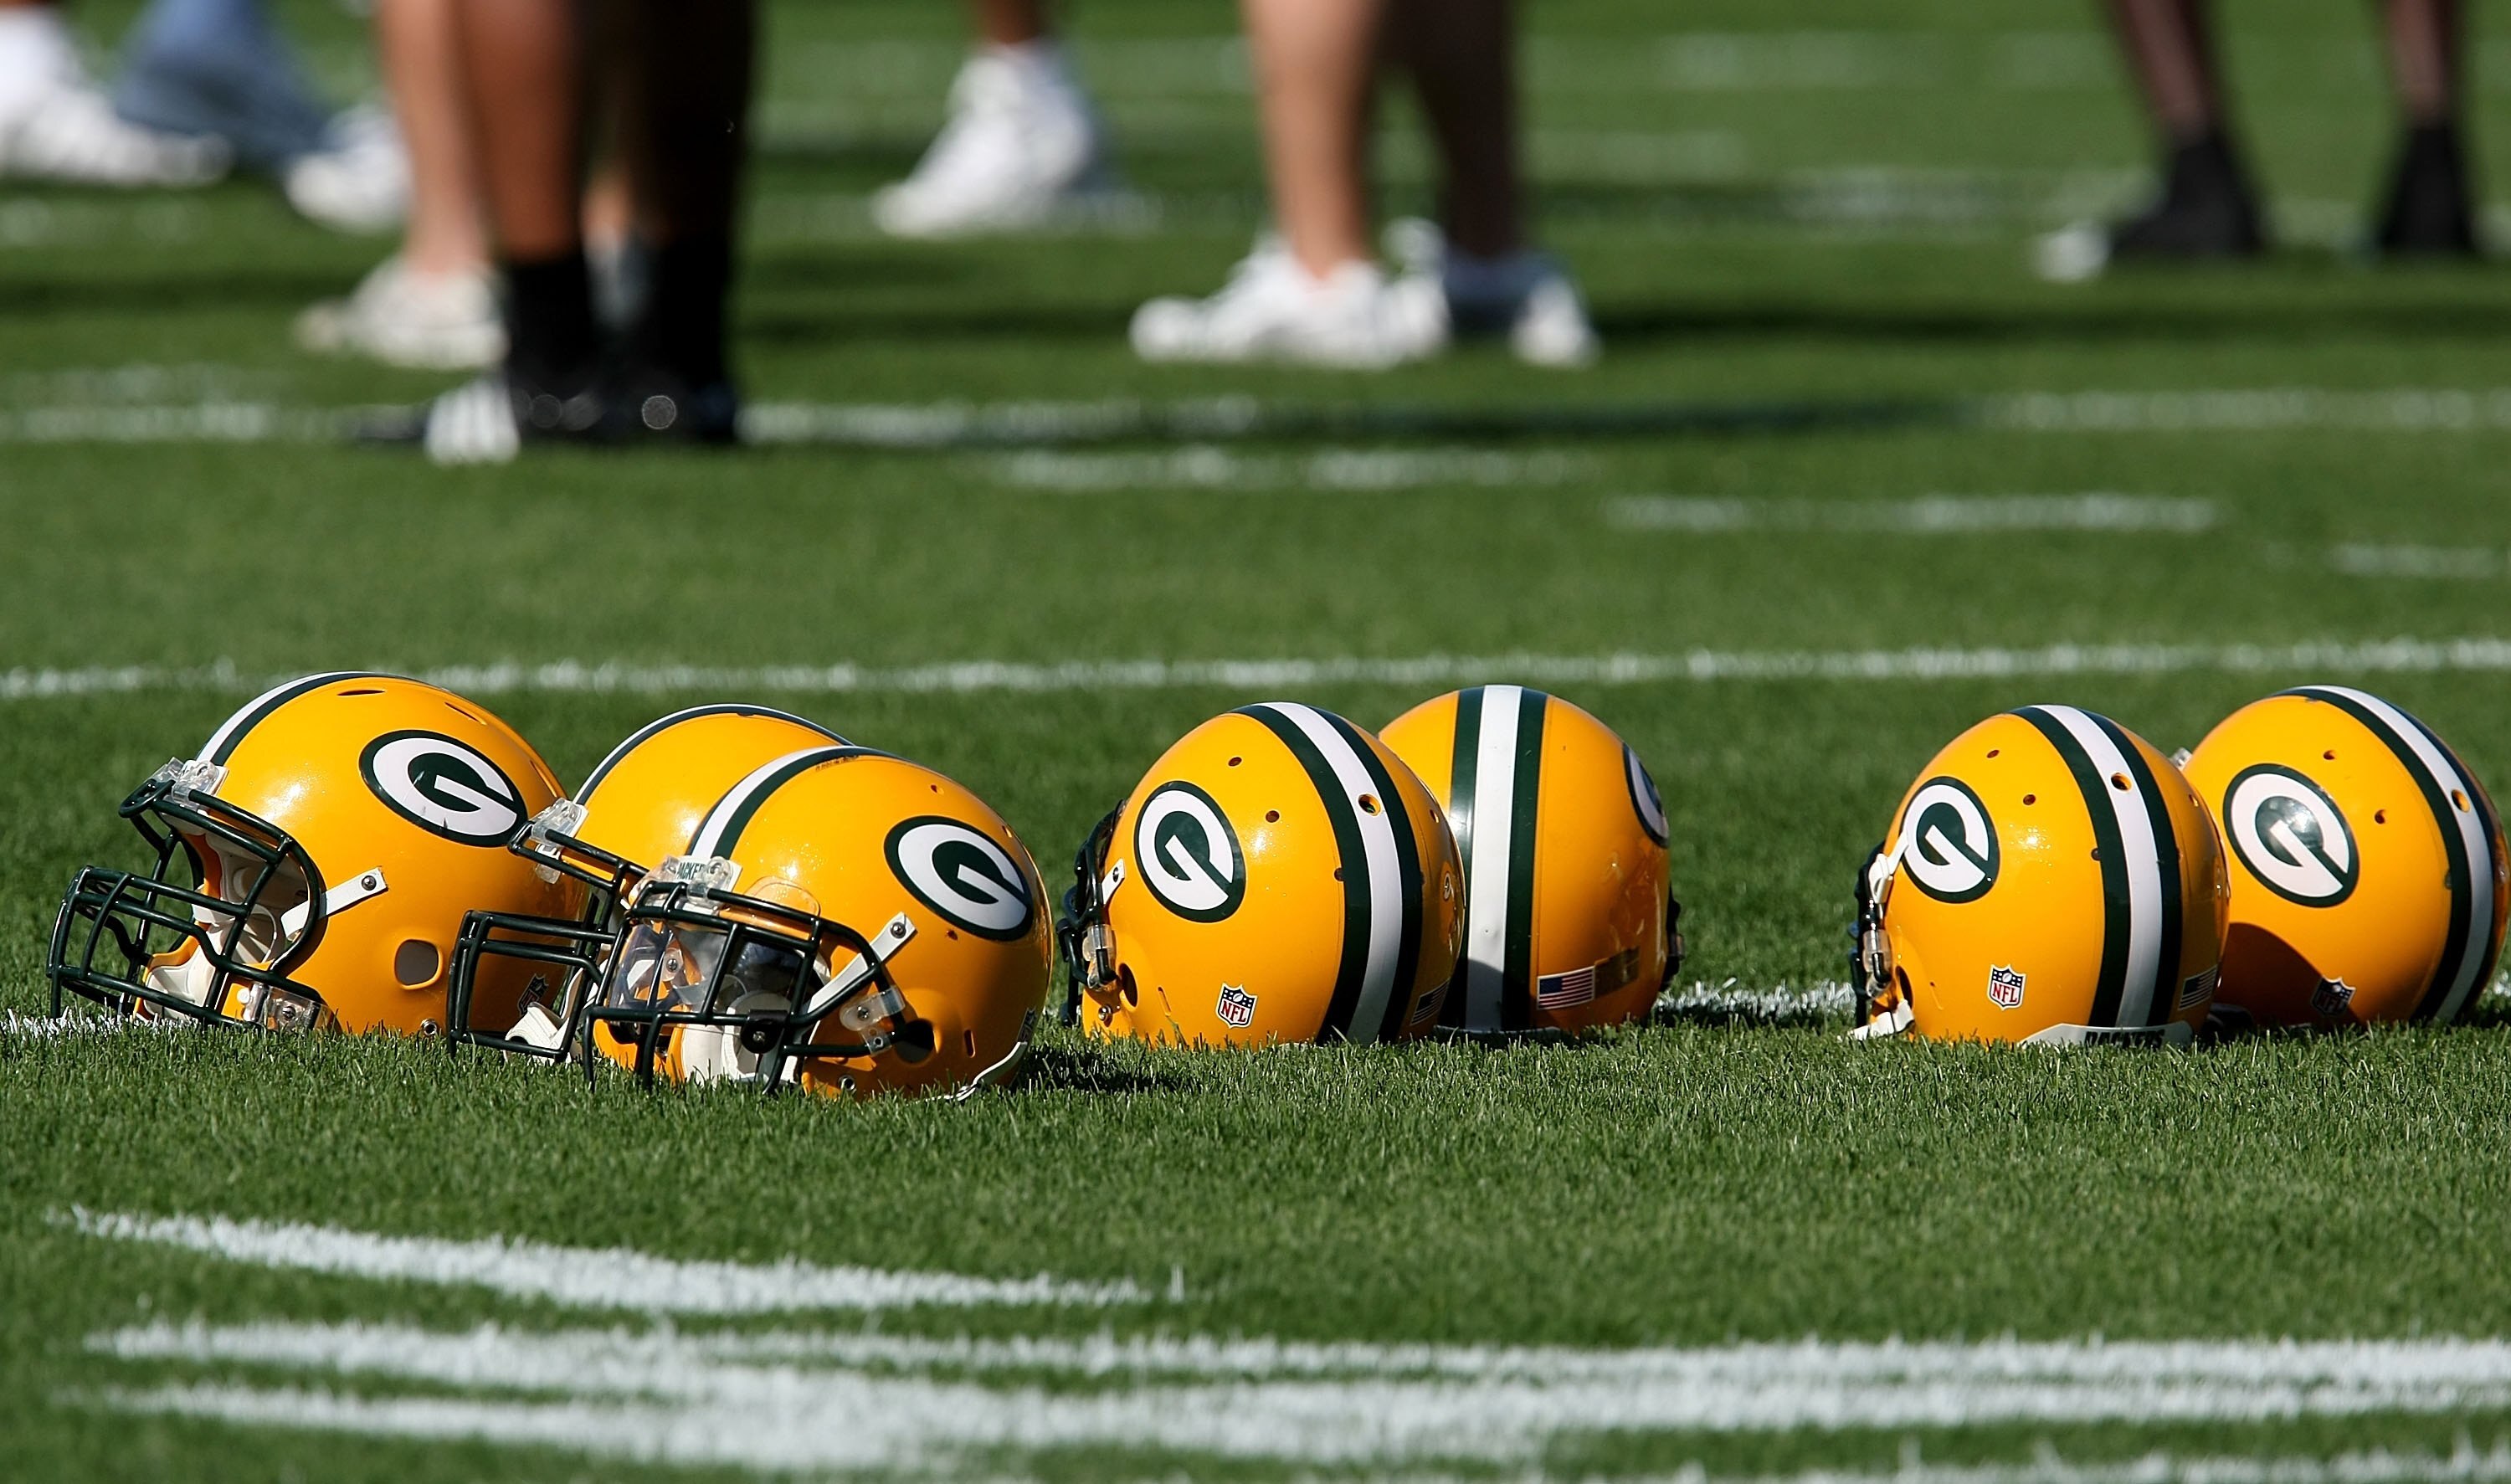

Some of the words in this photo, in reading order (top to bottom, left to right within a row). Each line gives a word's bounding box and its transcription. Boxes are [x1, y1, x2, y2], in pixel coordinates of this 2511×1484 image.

[373, 737, 517, 836] G
[2231, 773, 2350, 898] G
[898, 824, 1028, 930] G
[1138, 789, 1234, 911] G
[1220, 999, 1246, 1023] NFL
[1992, 982, 2018, 1004] NFL
